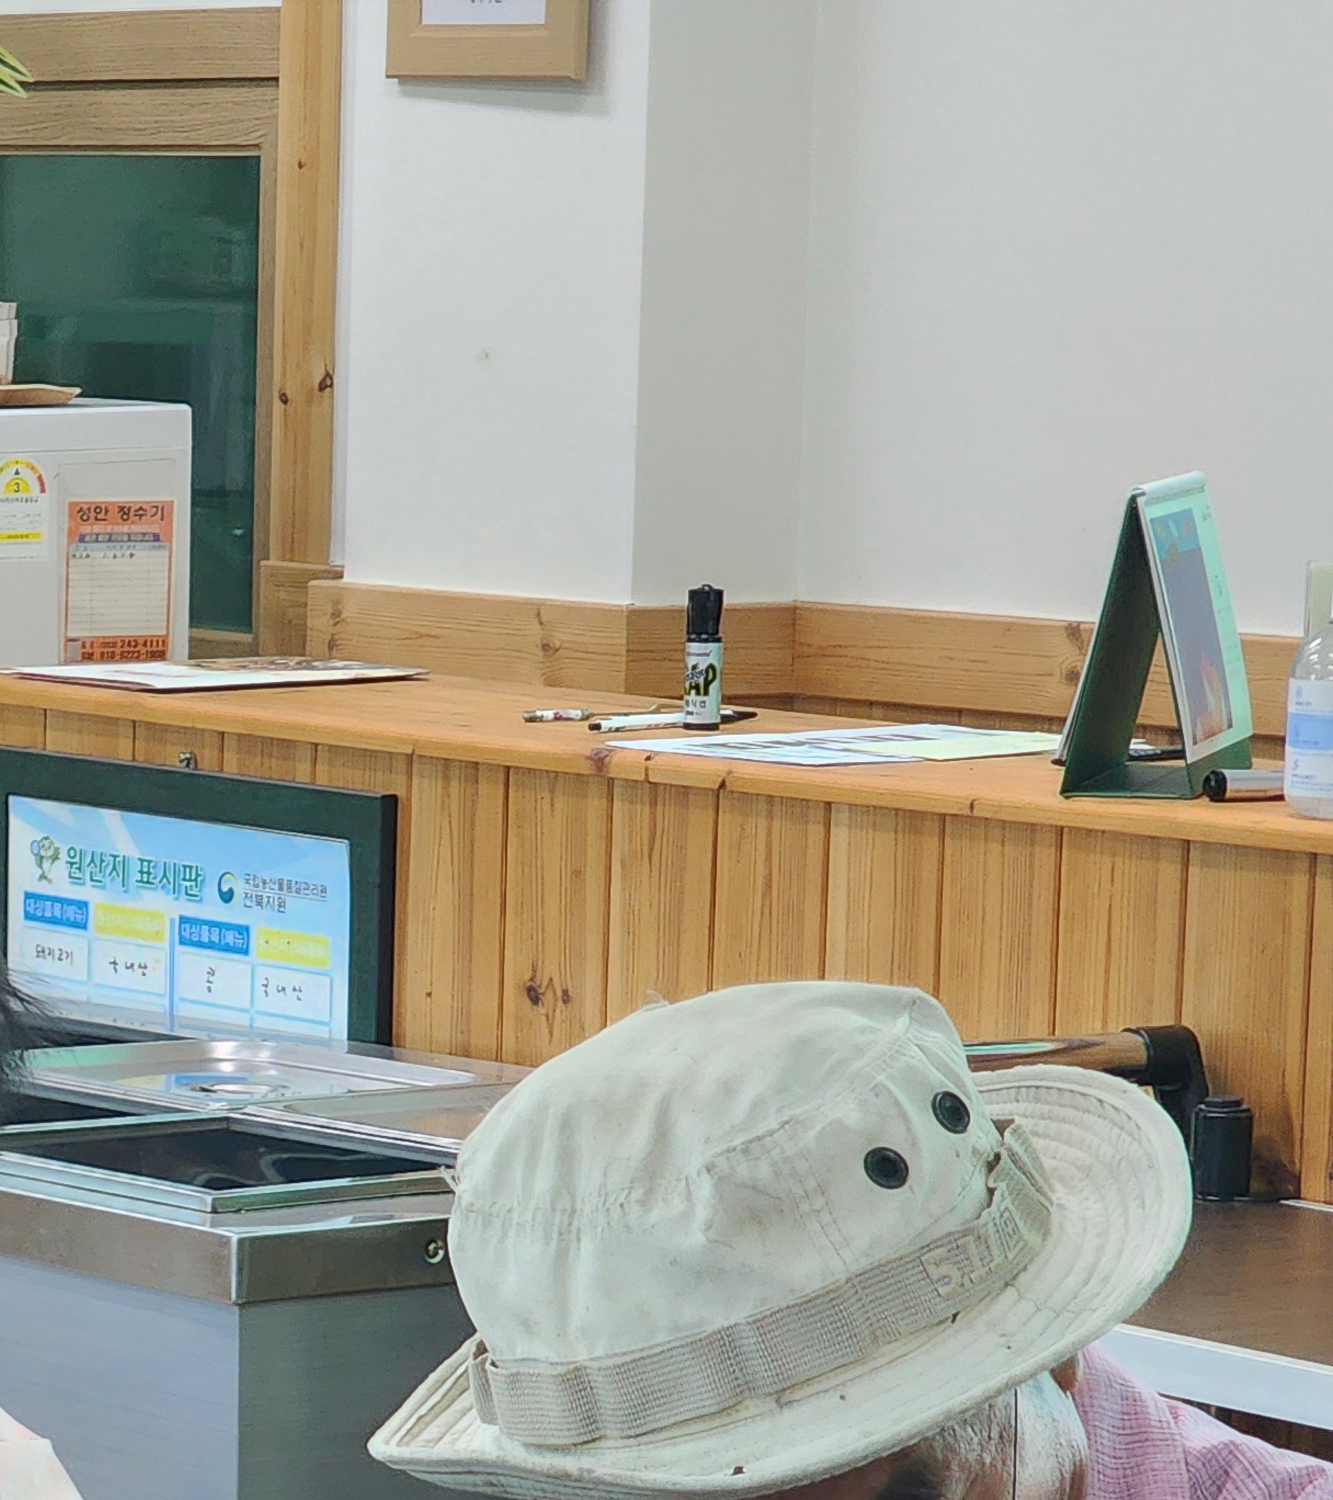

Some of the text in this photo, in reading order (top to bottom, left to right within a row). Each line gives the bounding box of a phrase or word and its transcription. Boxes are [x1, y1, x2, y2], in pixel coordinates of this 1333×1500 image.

[13, 482, 21, 493] 3
[76, 505, 165, 522] 성안 정수기
[65, 845, 203, 899] 원산지 표시판
[243, 891, 286, 914] 전북지원
